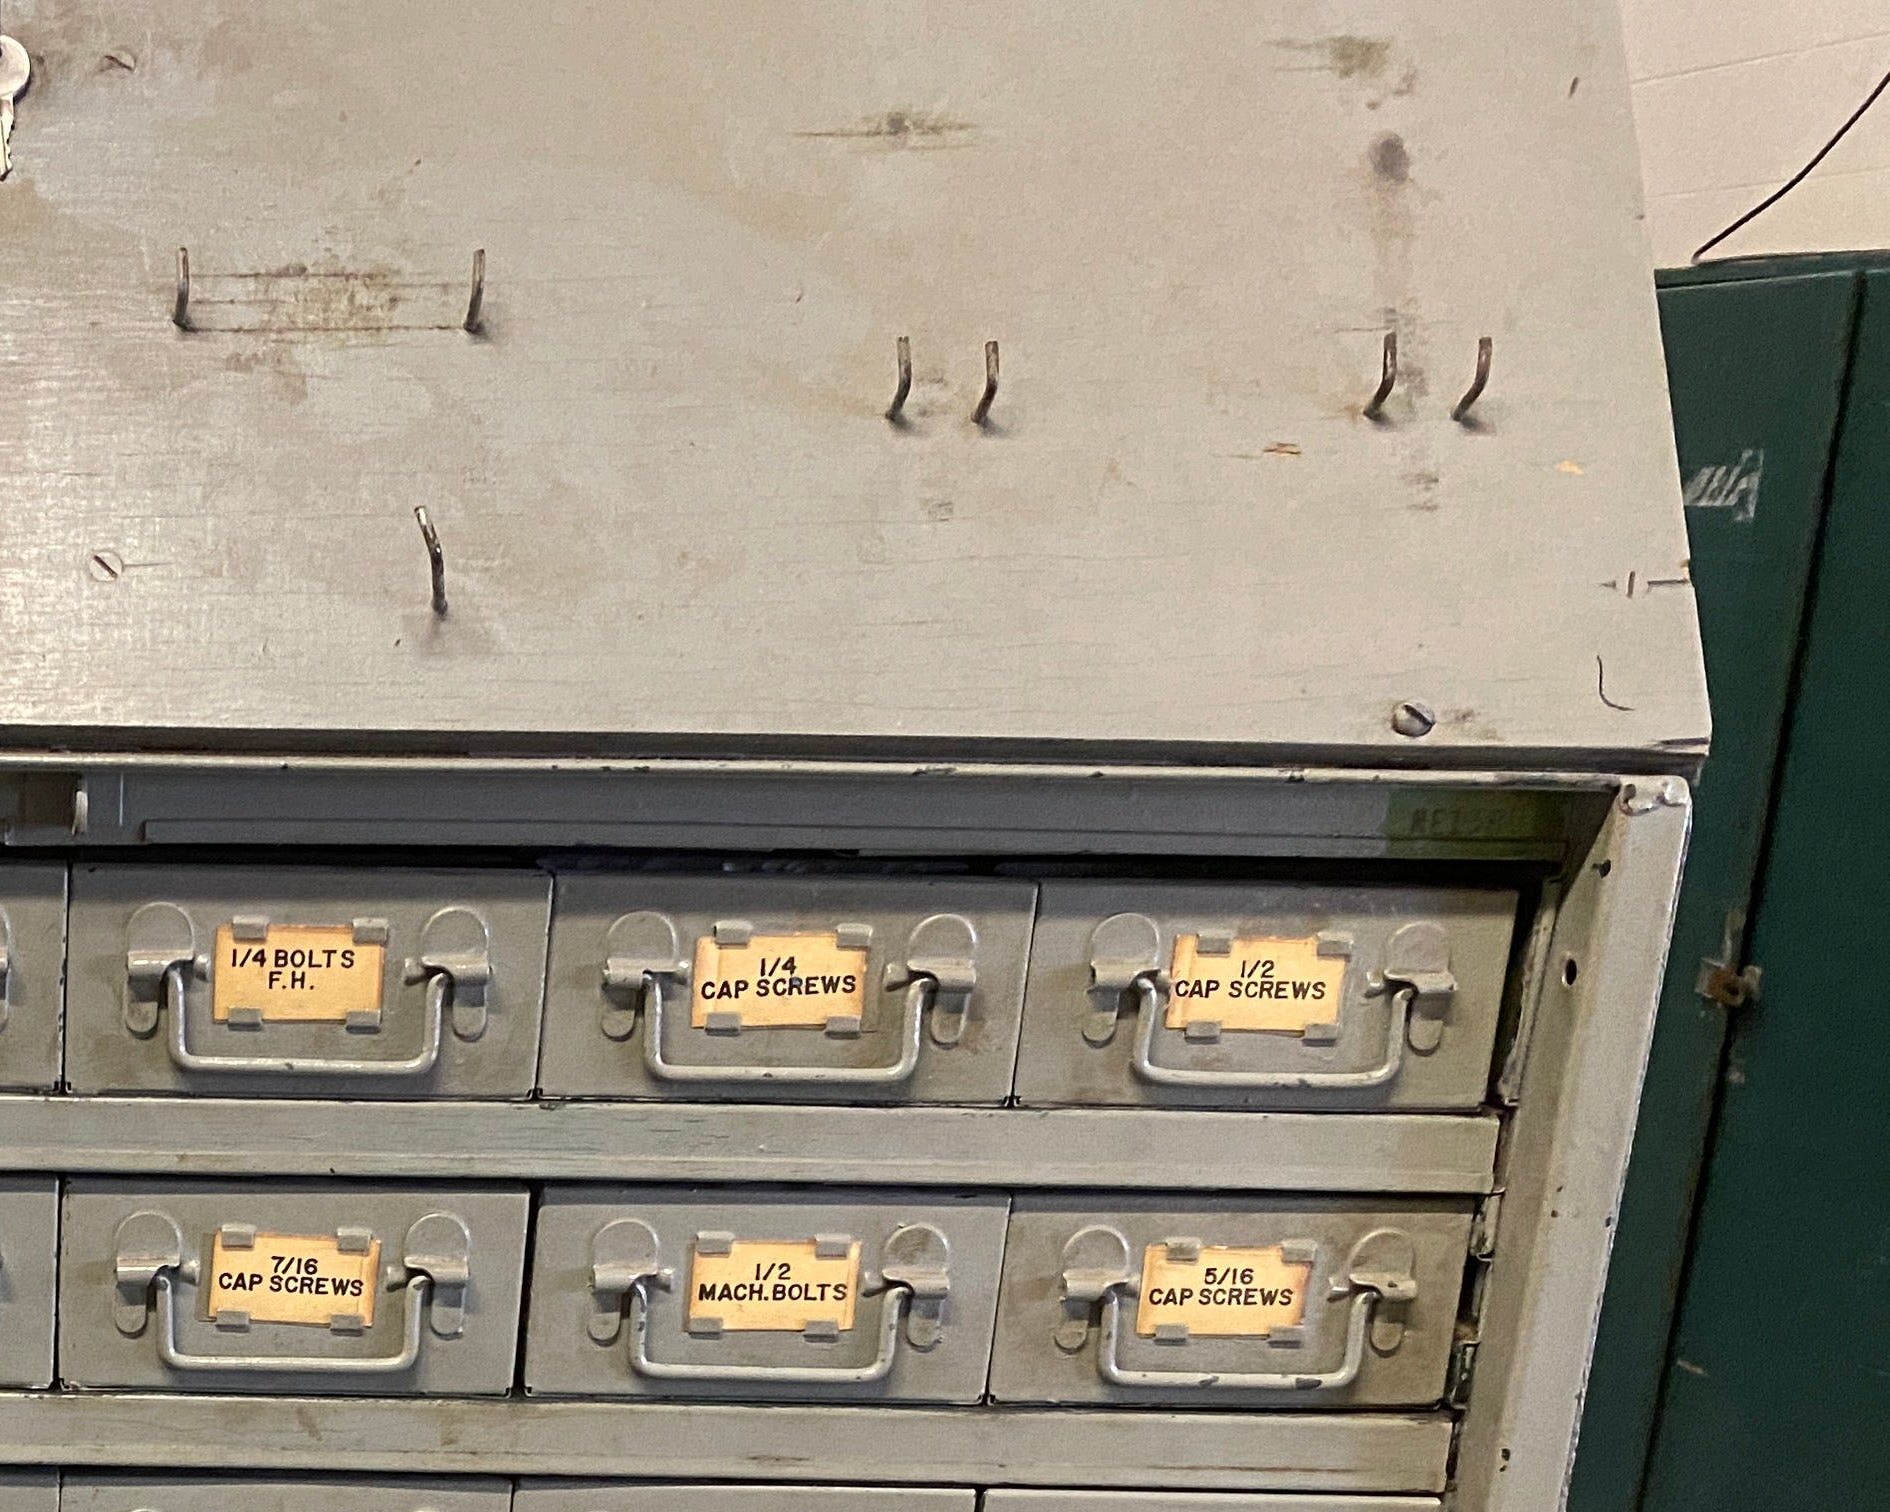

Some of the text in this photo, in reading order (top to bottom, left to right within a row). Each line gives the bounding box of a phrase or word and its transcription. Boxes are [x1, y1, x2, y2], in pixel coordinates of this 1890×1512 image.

[232, 948, 355, 968] 1/4 BOLTS
[760, 957, 799, 978] 1/4
[1241, 960, 1274, 978] 1/2
[269, 971, 314, 990] F.H.
[701, 973, 856, 999] CAP SCREWS
[1175, 980, 1326, 999] CAP SCREWS
[271, 1256, 318, 1275] 7/16
[755, 1263, 790, 1280] 1/2
[219, 1273, 363, 1296] CAP SCREWS
[1204, 1274, 1255, 1293] 5/16
[1149, 1288, 1293, 1306] CAP SCREWS
